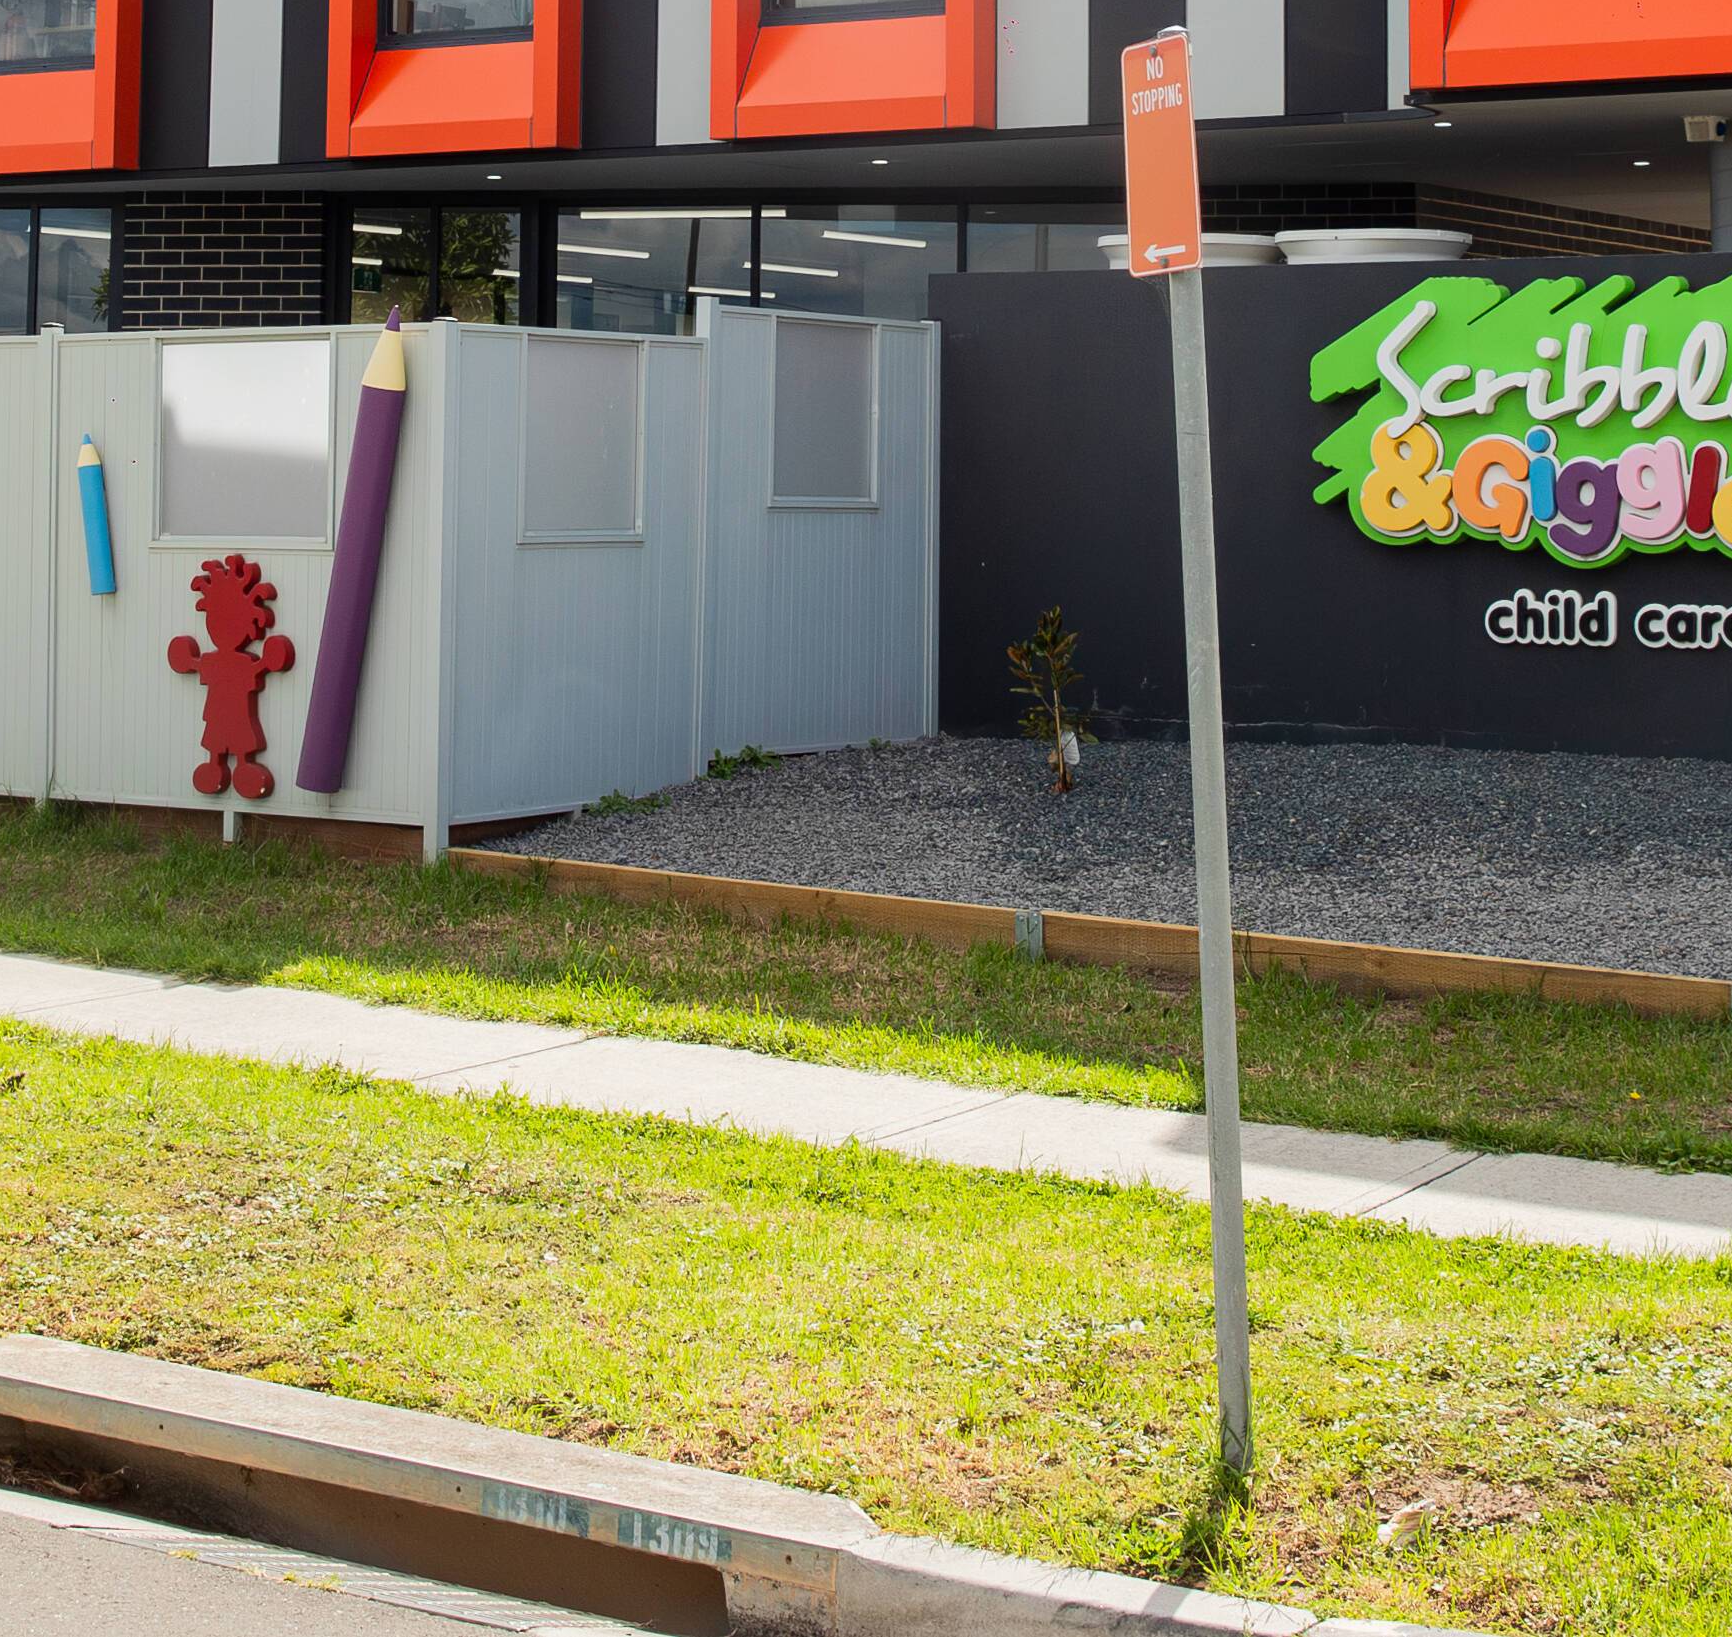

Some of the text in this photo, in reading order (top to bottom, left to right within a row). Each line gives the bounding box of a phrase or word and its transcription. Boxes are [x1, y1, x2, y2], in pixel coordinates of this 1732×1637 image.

[1146, 55, 1164, 81] NO
[1131, 82, 1183, 116] STOPPING
[1485, 590, 1615, 646] child
